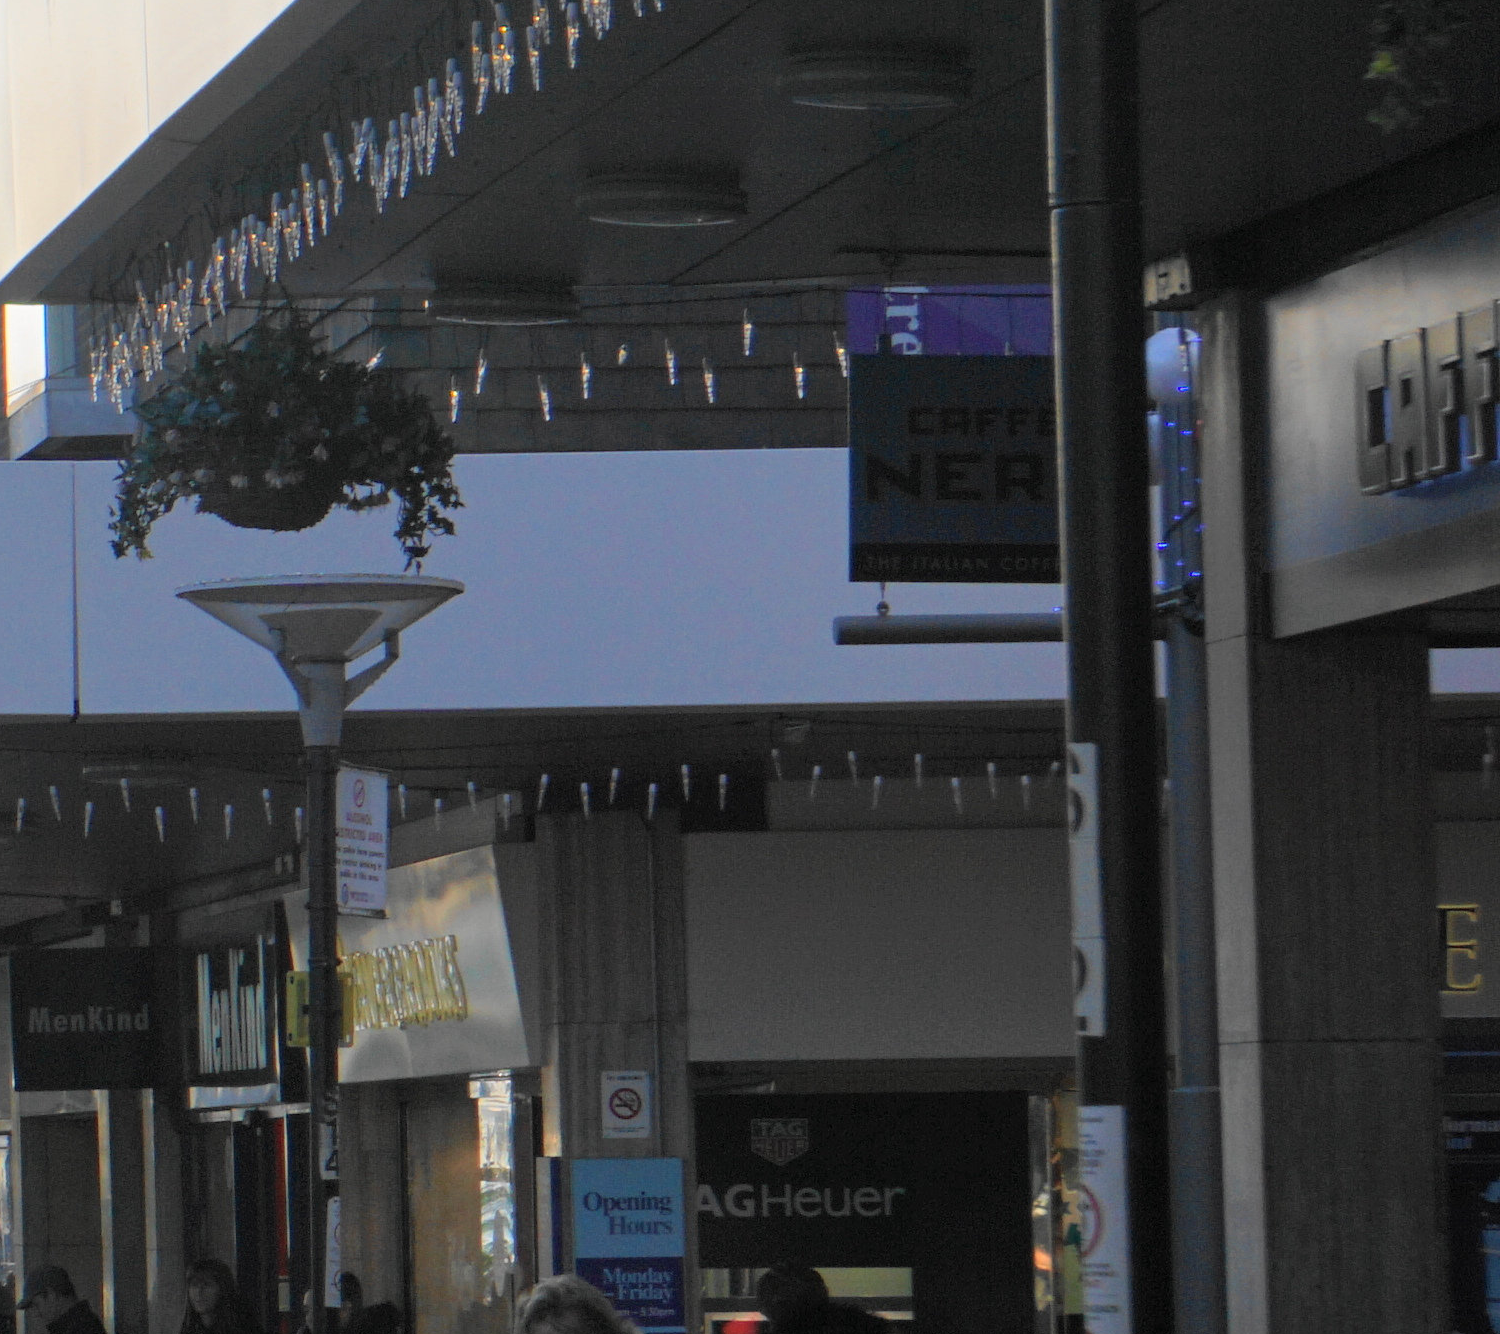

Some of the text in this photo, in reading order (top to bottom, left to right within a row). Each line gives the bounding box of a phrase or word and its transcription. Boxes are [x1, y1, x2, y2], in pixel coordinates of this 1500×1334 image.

[1356, 299, 1500, 496] CAFF
[865, 450, 1046, 503] NER
[912, 556, 990, 572] ITALIAN
[28, 1004, 149, 1033] MenKind
[757, 1121, 804, 1136] TAG
[583, 1191, 673, 1217] Opening
[696, 1183, 907, 1217] AGHeuer
[609, 1215, 673, 1235] Hours
[603, 1267, 673, 1288] Monday
[618, 1284, 673, 1304] Friday
